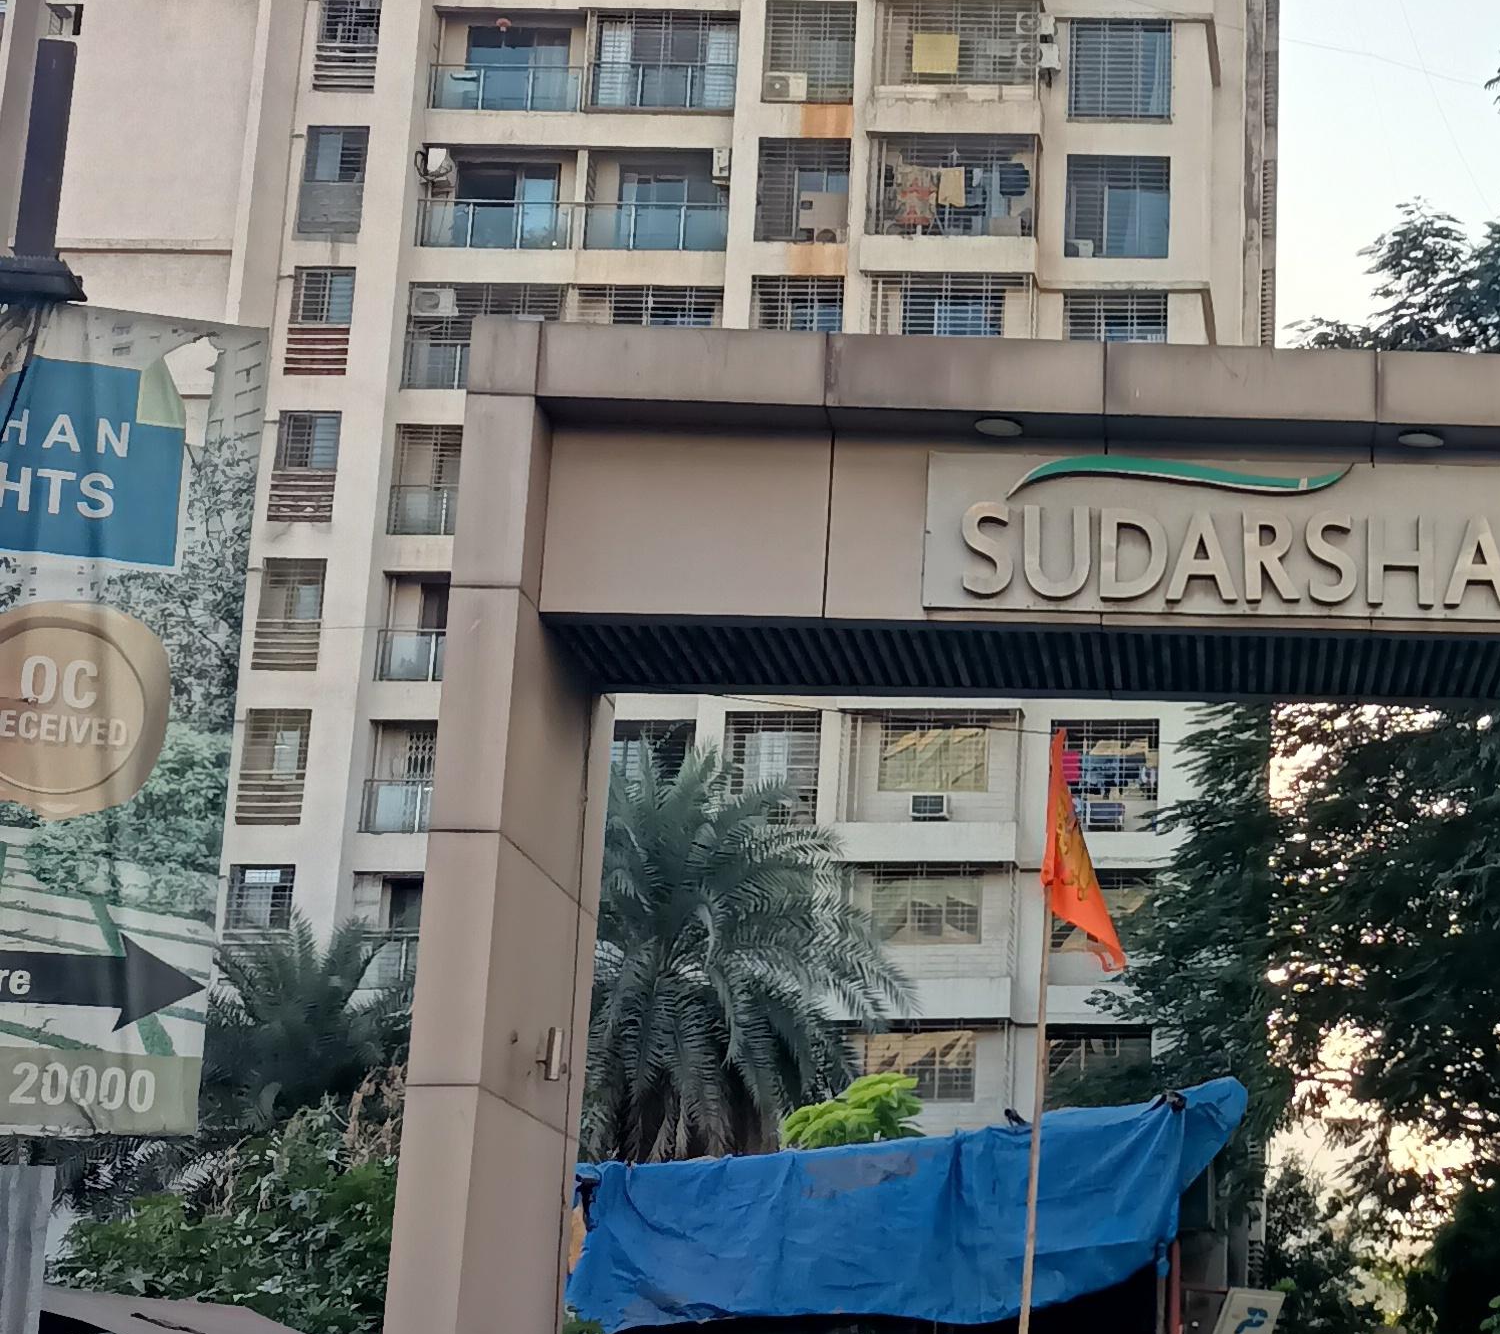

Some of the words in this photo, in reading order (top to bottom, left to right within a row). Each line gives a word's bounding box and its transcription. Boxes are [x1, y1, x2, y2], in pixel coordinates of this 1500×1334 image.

[0, 462, 114, 519] HTS
[20, 655, 98, 709] OC
[9, 1061, 156, 1113] 20000
